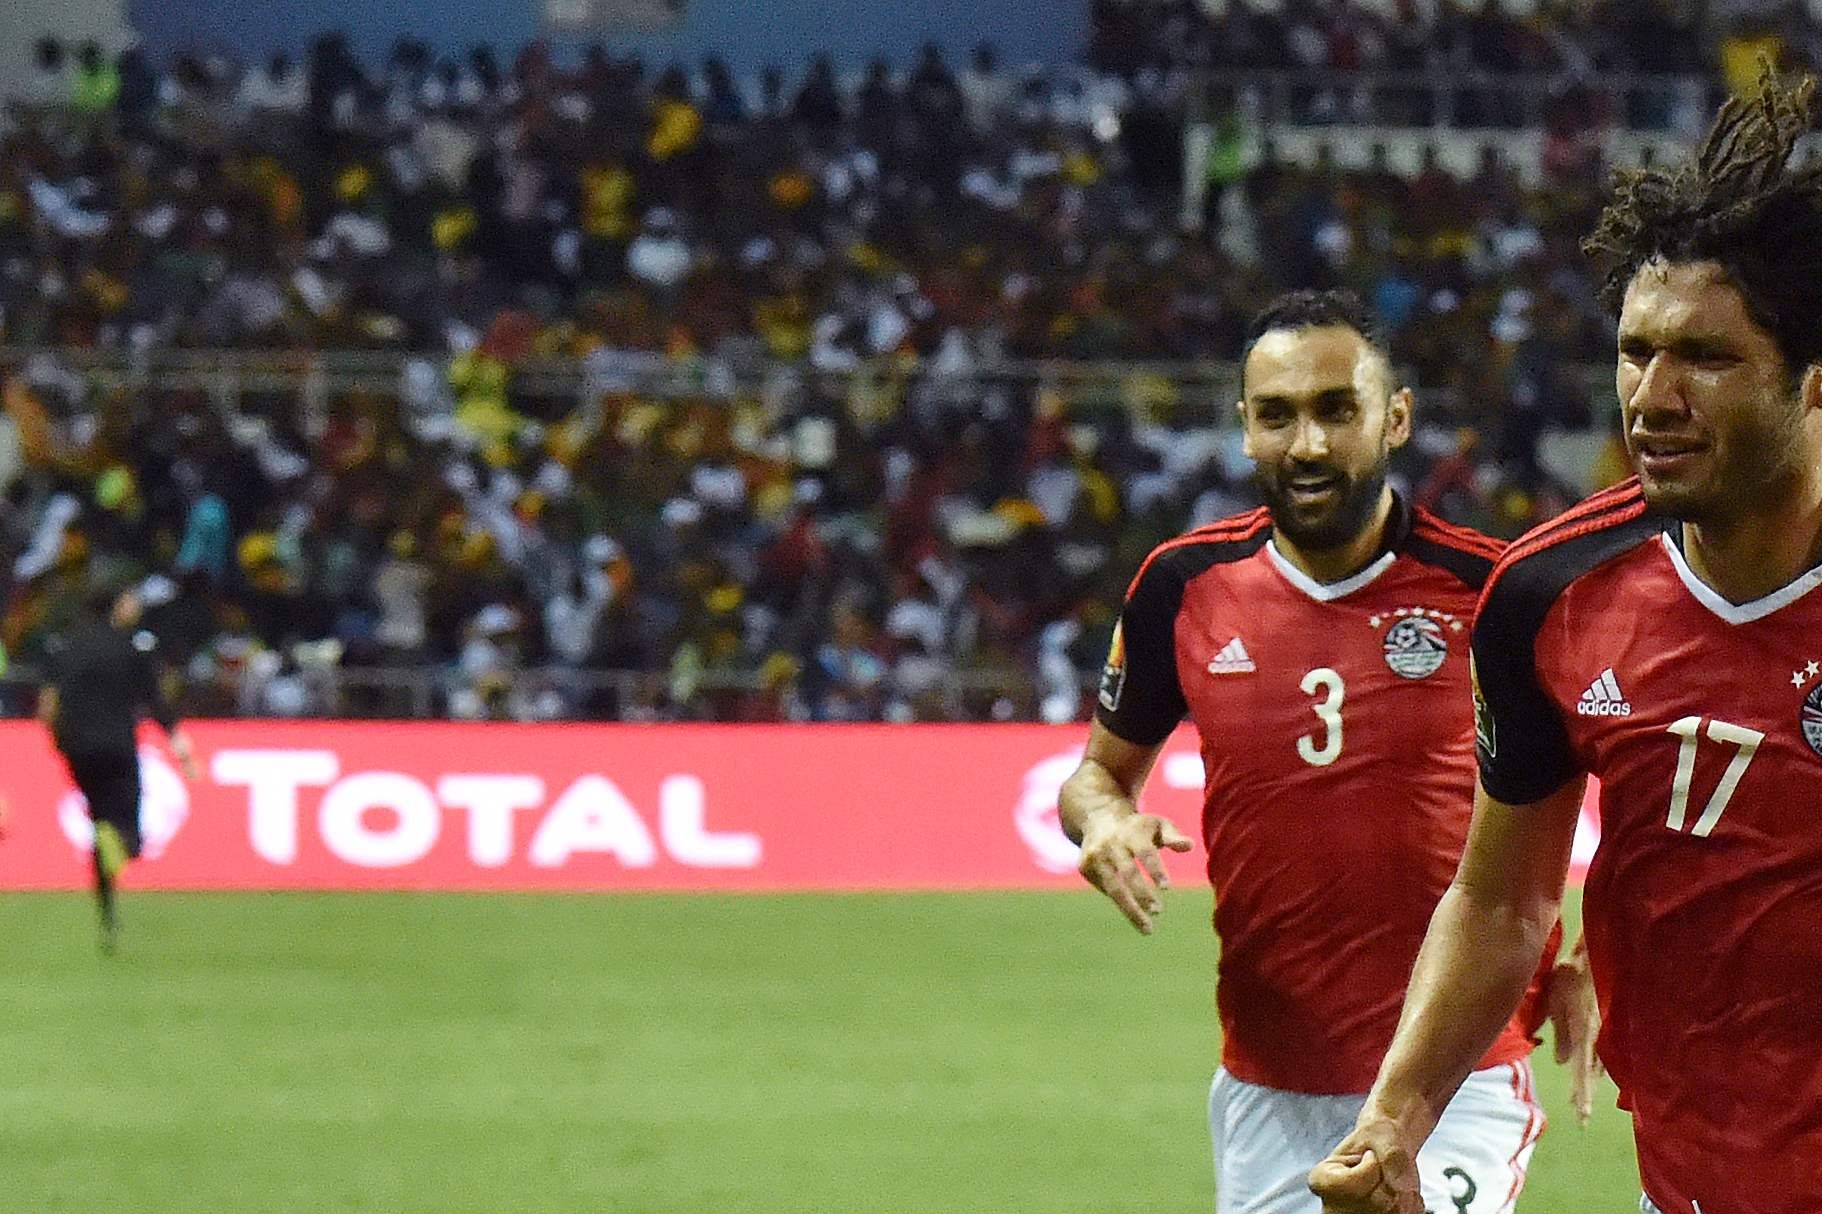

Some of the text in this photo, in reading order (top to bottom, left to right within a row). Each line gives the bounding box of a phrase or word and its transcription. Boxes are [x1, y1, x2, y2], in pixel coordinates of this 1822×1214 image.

[1296, 667, 1345, 767] 3
[1577, 699, 1631, 716] adidas
[210, 749, 762, 867] TOTAL
[1666, 715, 1766, 838] 17
